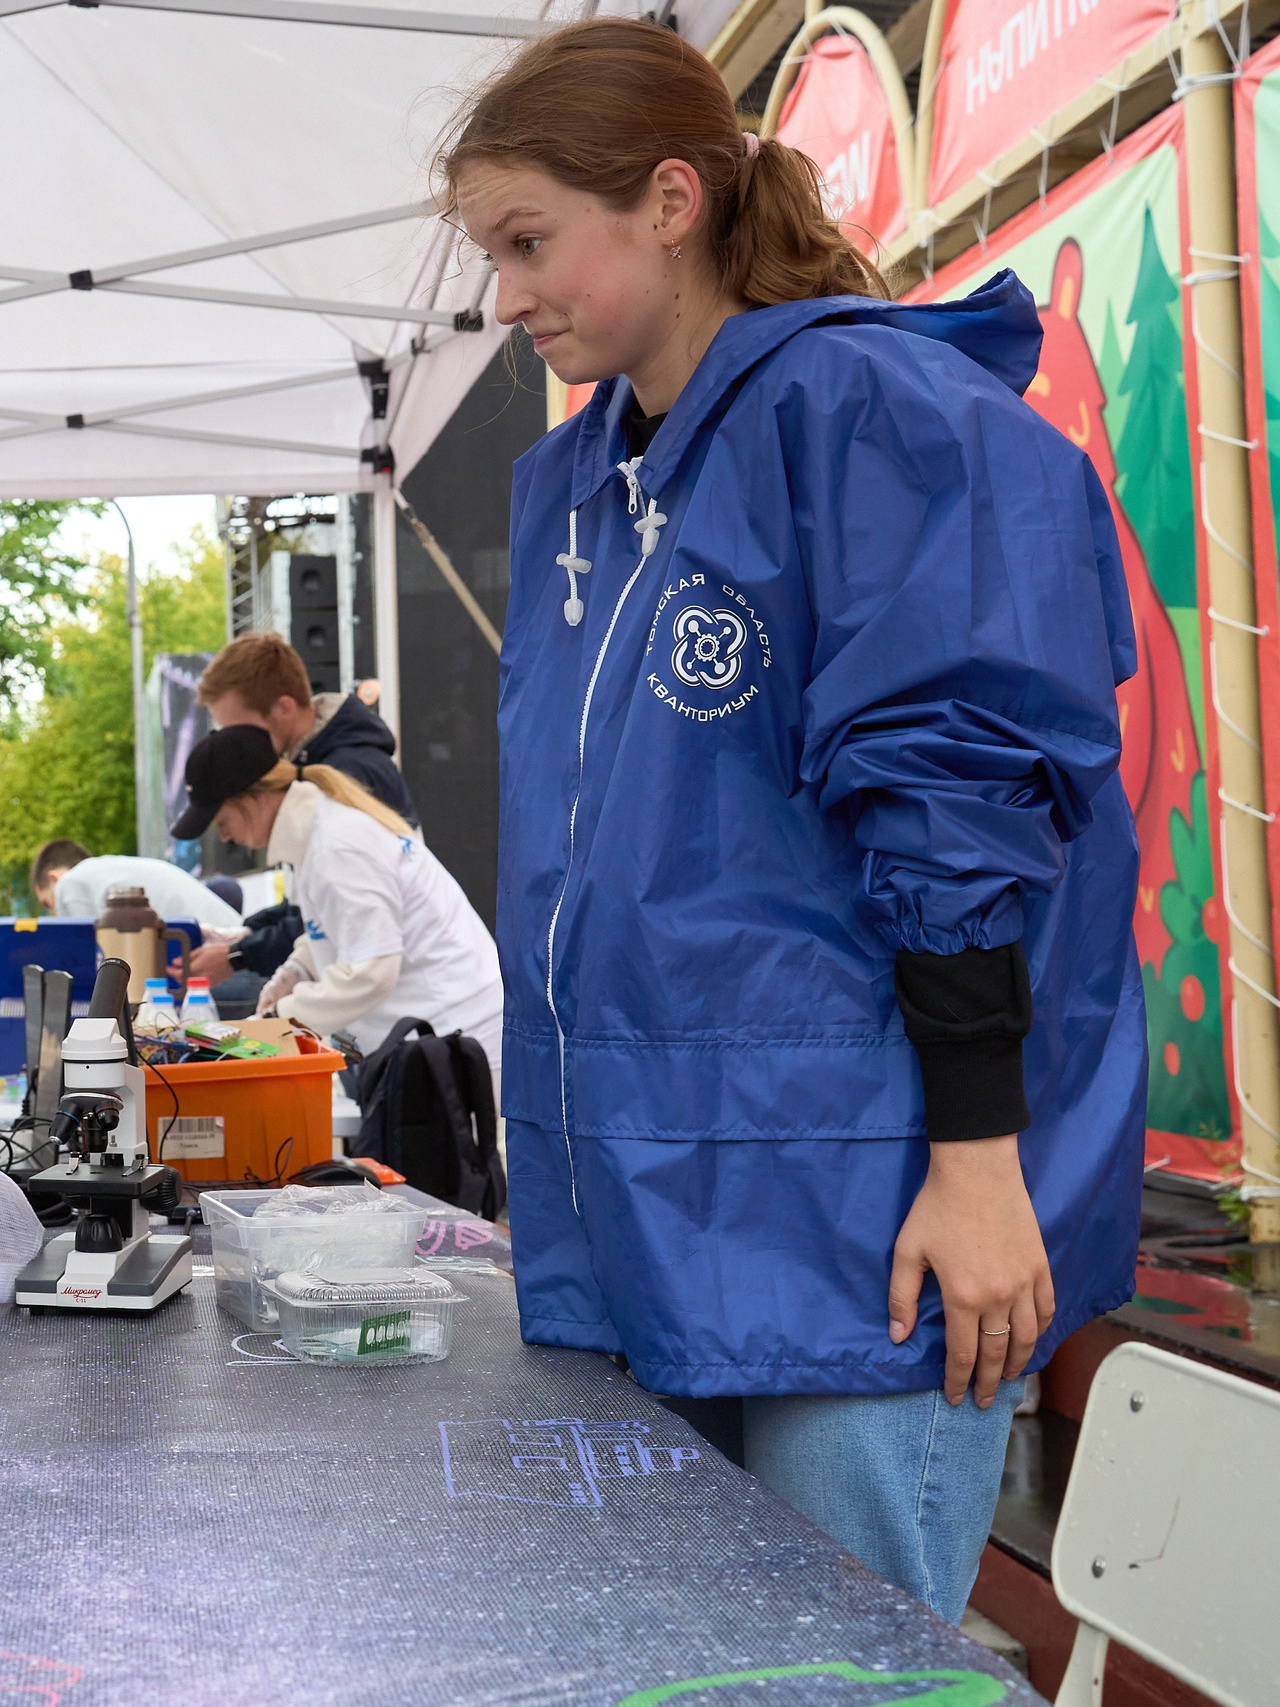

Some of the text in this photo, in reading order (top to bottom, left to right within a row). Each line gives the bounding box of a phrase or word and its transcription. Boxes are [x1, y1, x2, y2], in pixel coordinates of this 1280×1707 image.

[645, 573, 773, 668] ТОМСКАЯ ОБЛАСТЬ
[646, 672, 759, 722] КВАНТОРИУМ
